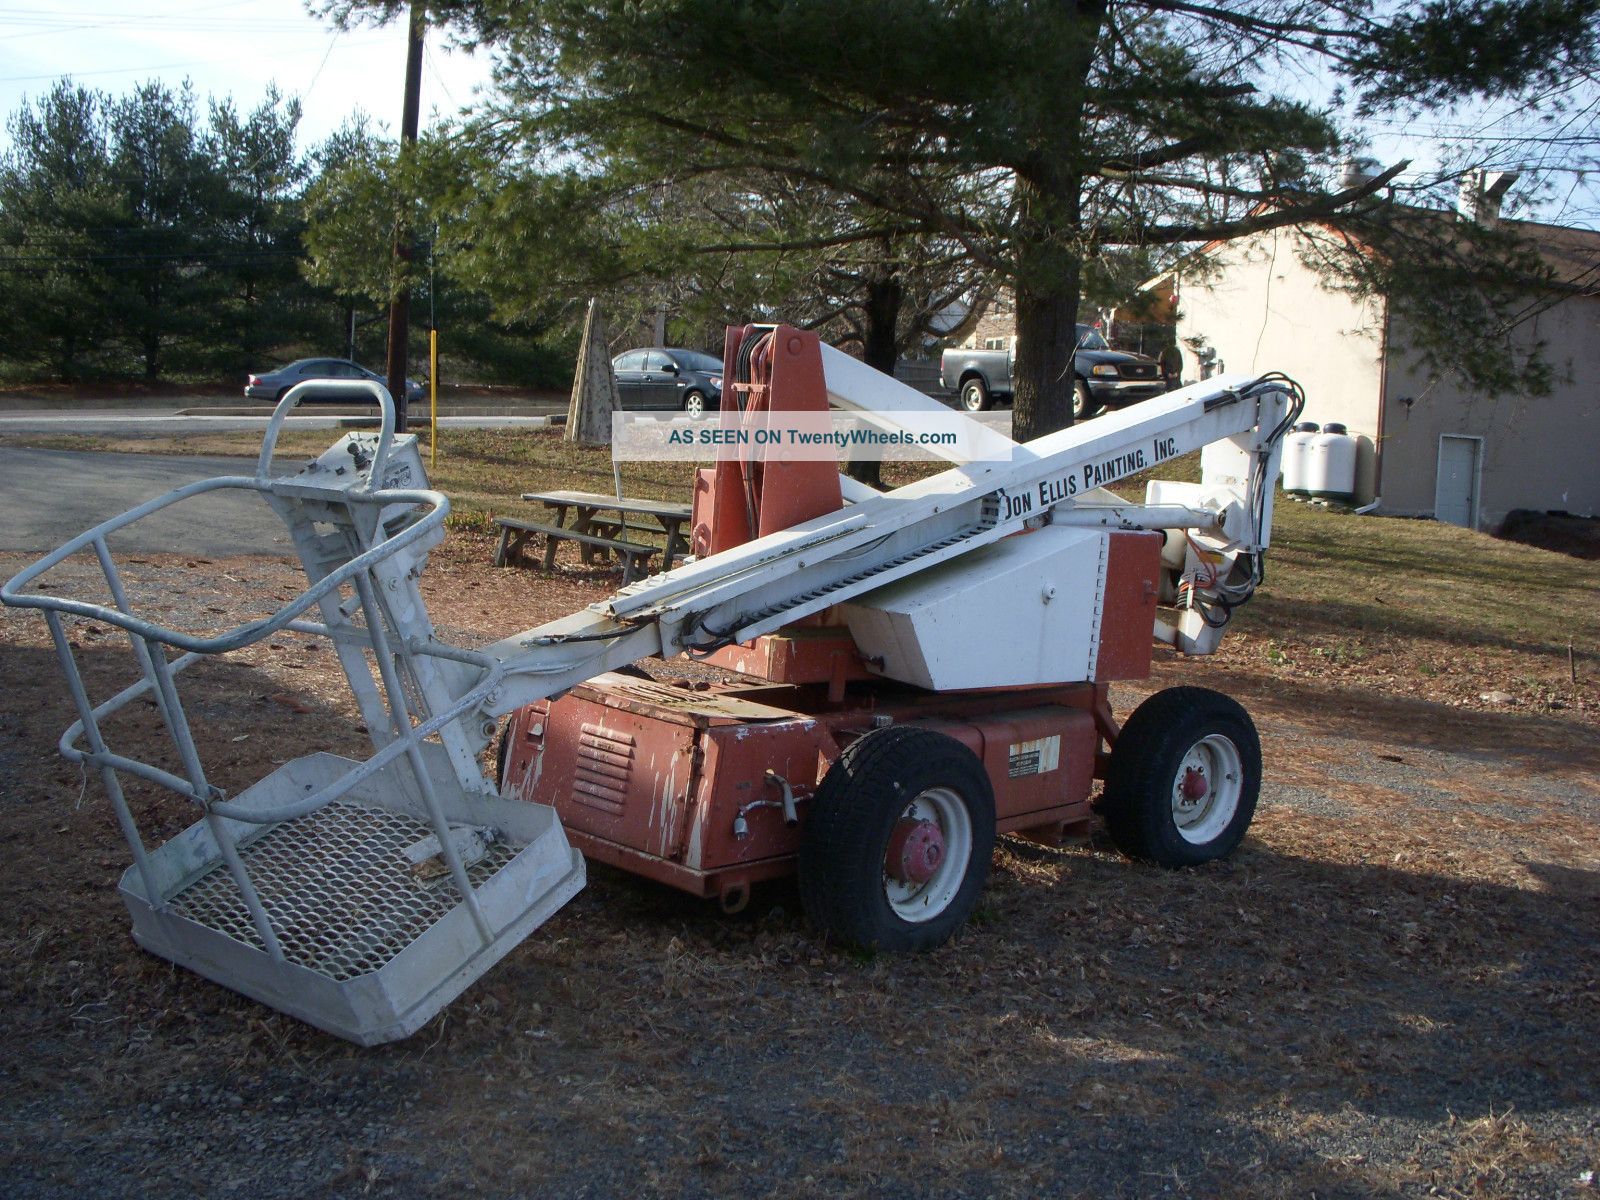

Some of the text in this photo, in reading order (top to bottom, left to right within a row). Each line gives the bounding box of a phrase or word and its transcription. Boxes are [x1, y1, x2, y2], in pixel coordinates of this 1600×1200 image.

[1039, 474, 1077, 507] ELLIS
[1083, 449, 1148, 489] PAINTING,
[1153, 437, 1179, 462] INC.
